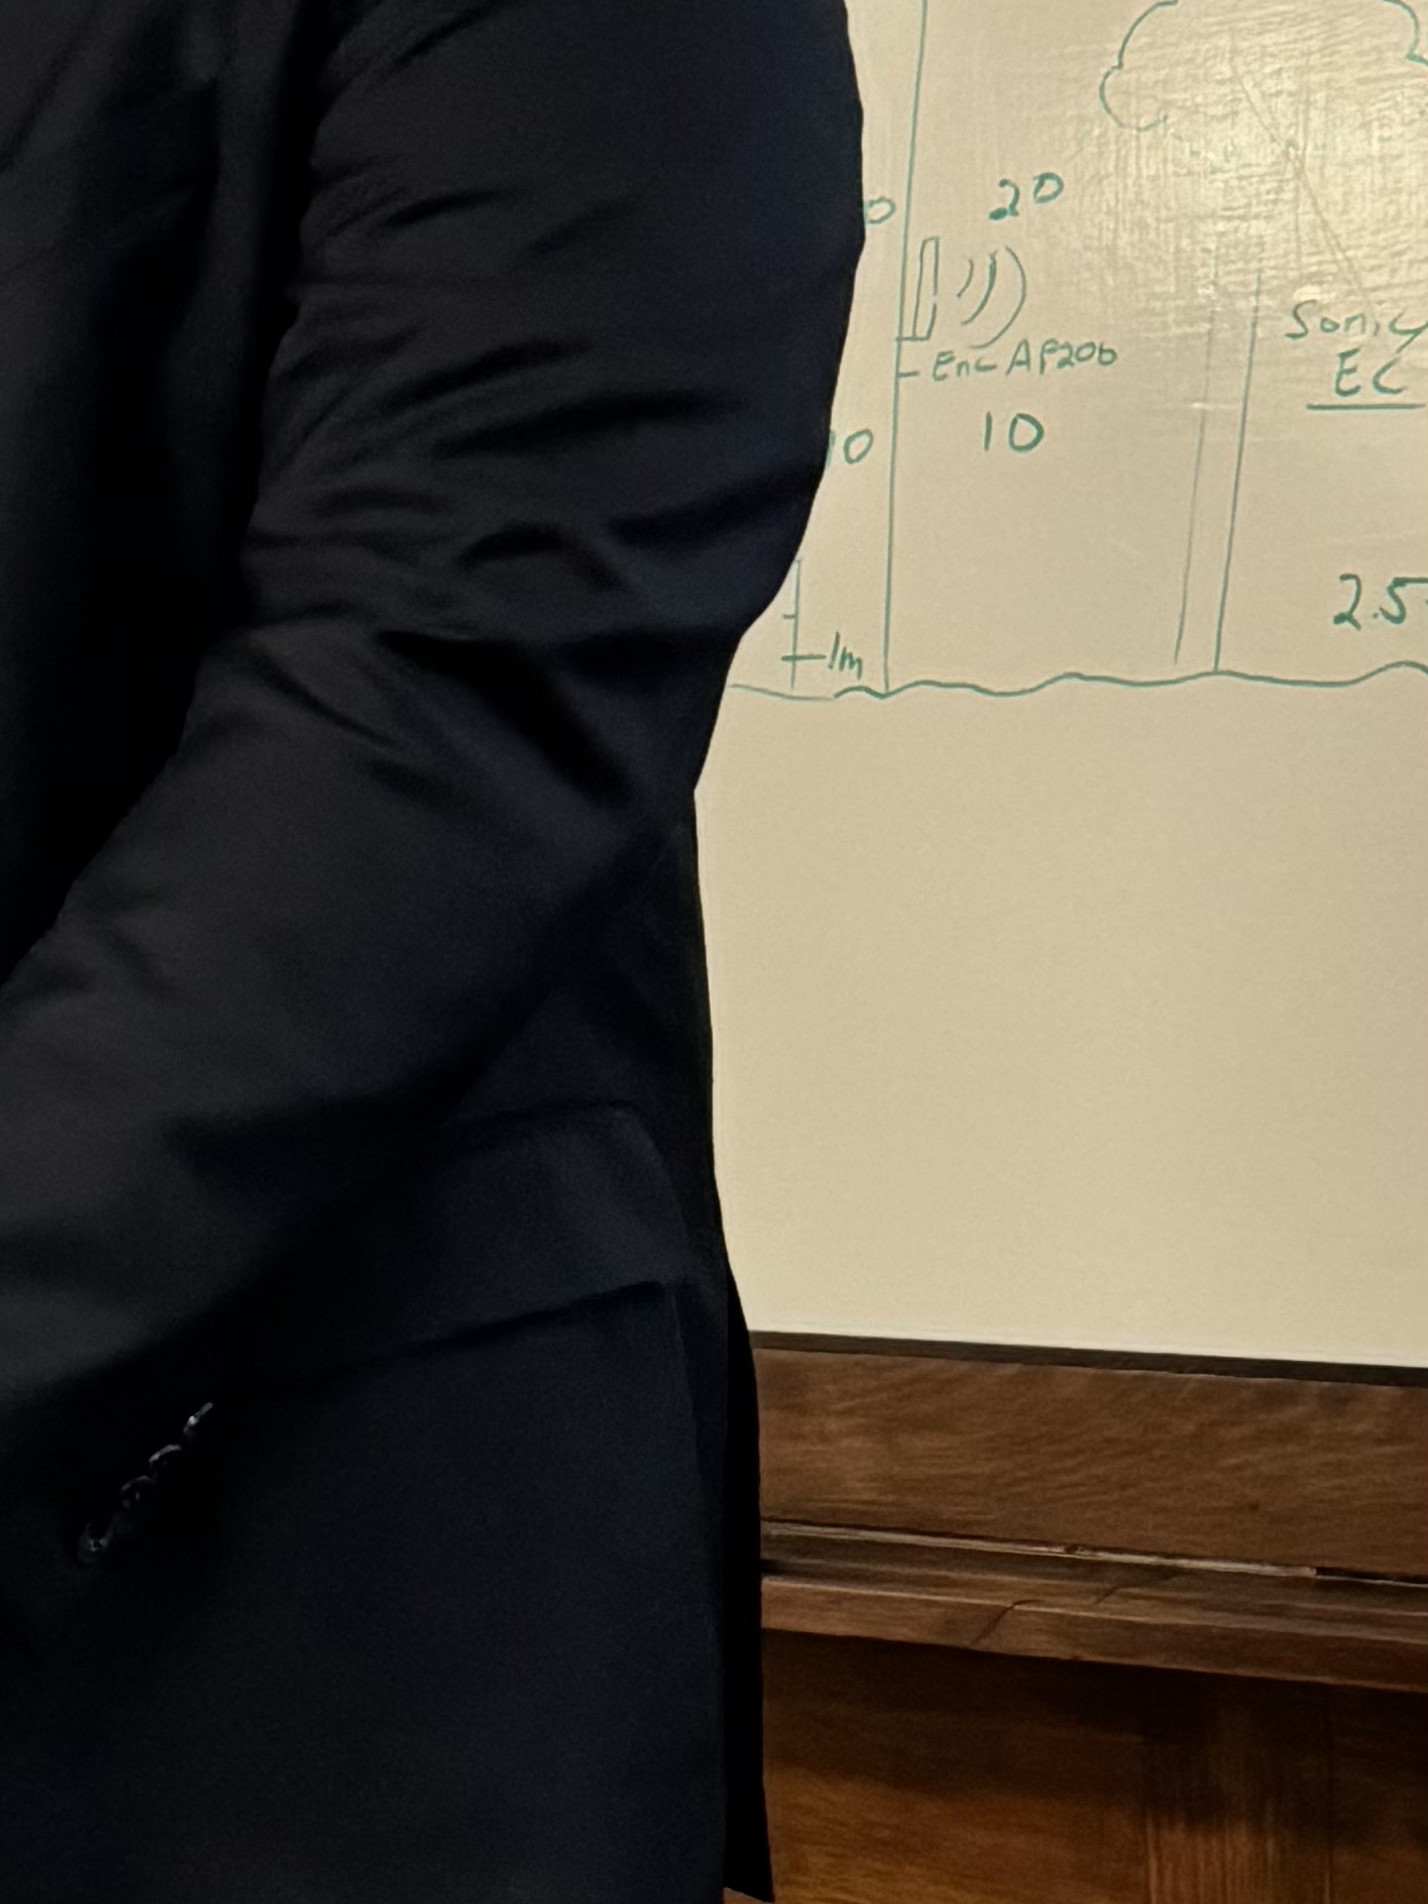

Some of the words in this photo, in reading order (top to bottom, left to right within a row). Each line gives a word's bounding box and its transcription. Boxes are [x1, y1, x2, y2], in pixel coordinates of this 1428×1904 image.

[988, 172, 1065, 220] 20
[1334, 347, 1409, 398] EC
[983, 410, 1045, 454] 10
